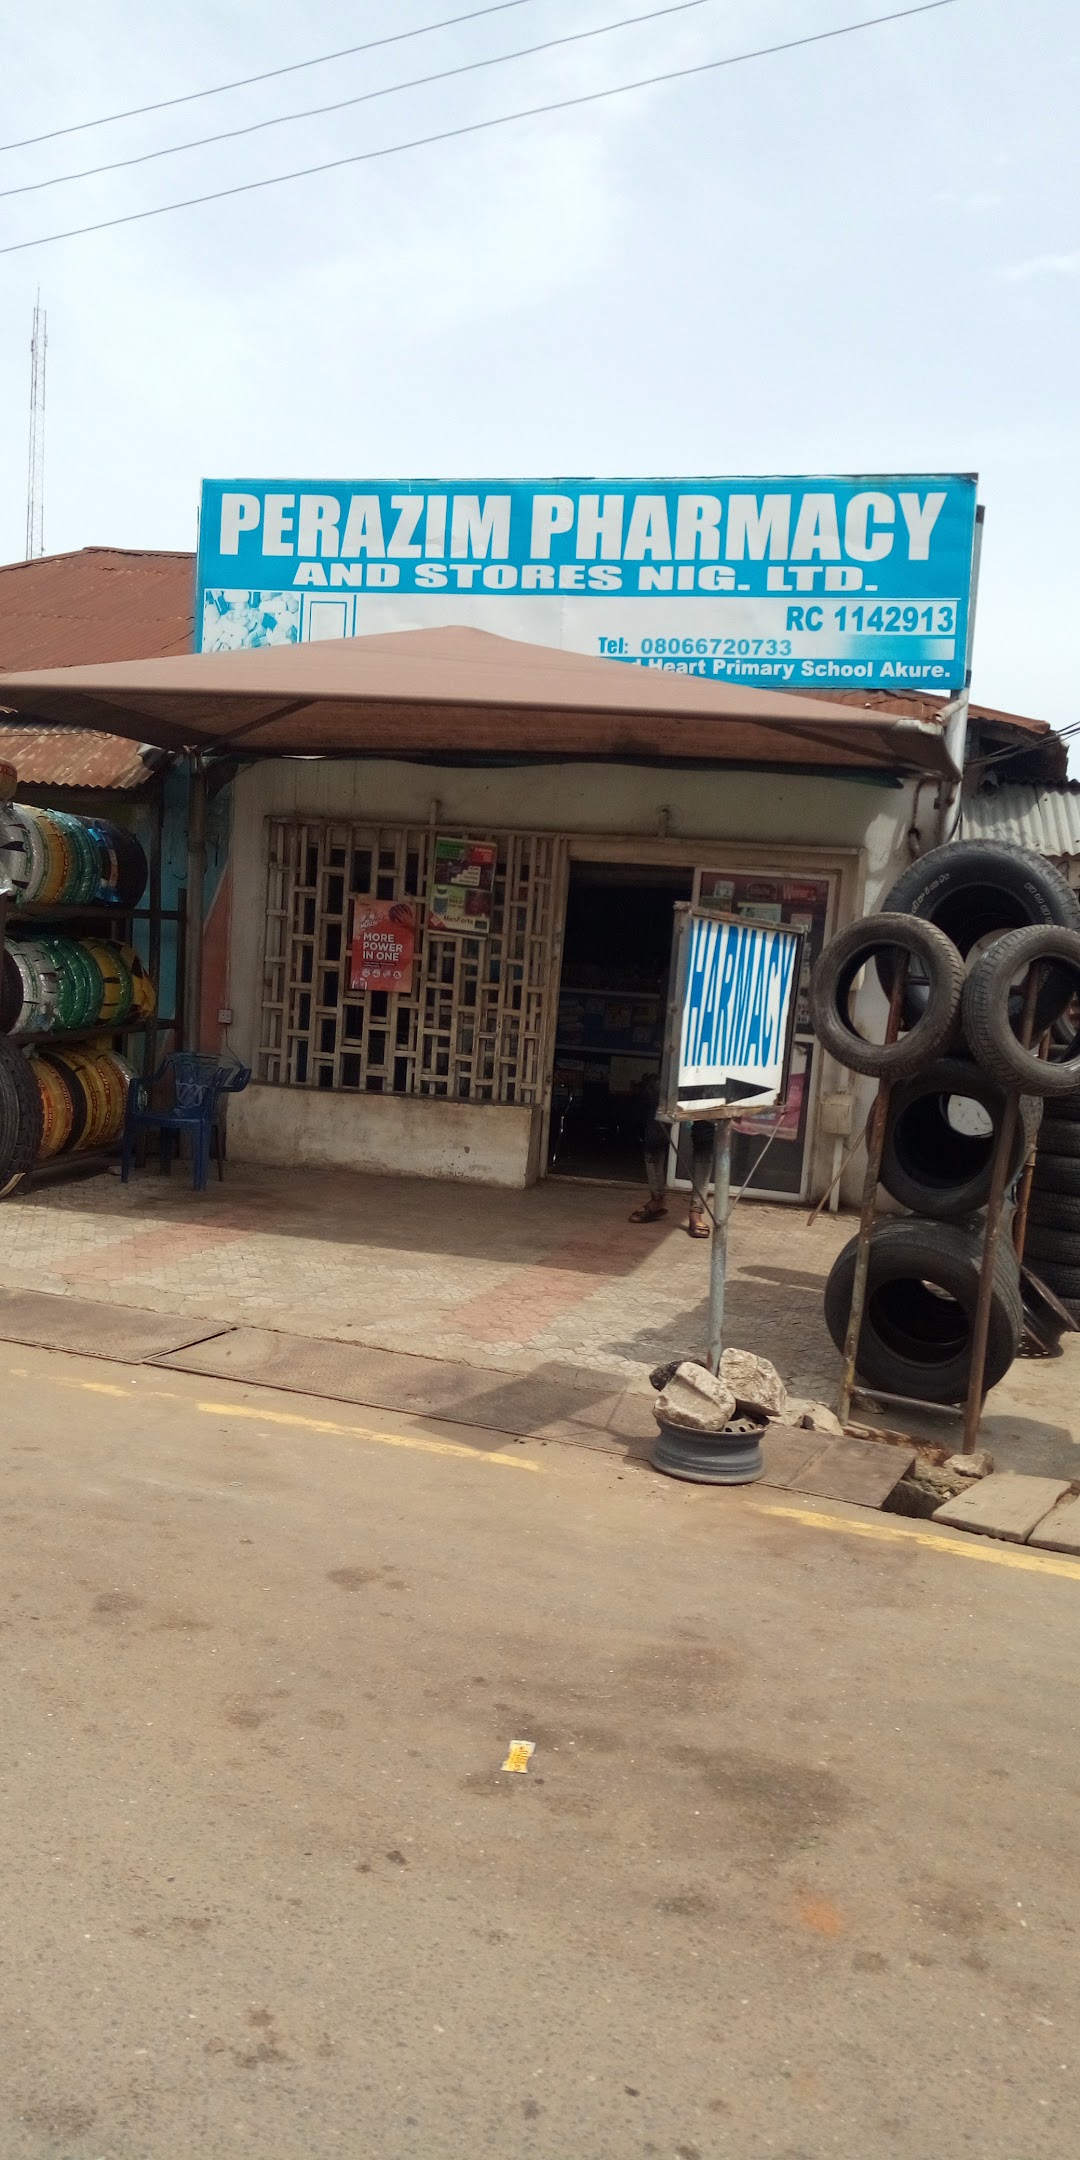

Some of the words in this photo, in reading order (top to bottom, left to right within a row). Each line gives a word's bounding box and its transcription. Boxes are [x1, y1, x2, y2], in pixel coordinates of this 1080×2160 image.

[219, 493, 511, 560] PERAZIM
[530, 491, 948, 562] PHARMACY
[292, 562, 400, 587] AND
[414, 563, 623, 591] STORES
[638, 565, 750, 591] NIG.
[766, 565, 878, 592] LTD.
[786, 606, 824, 631] RC
[834, 605, 954, 632] 1142913
[598, 636, 629, 654] Tel:
[641, 637, 792, 656] 08066720733
[648, 658, 706, 675] Heart
[712, 658, 796, 680] Primary
[801, 660, 873, 678] School
[880, 660, 951, 678] Akure.
[362, 941, 404, 953] POWER
[363, 932, 395, 943] MORE
[362, 950, 375, 960] IN
[376, 951, 400, 962] ONE
[683, 918, 797, 1068] HARMACY
